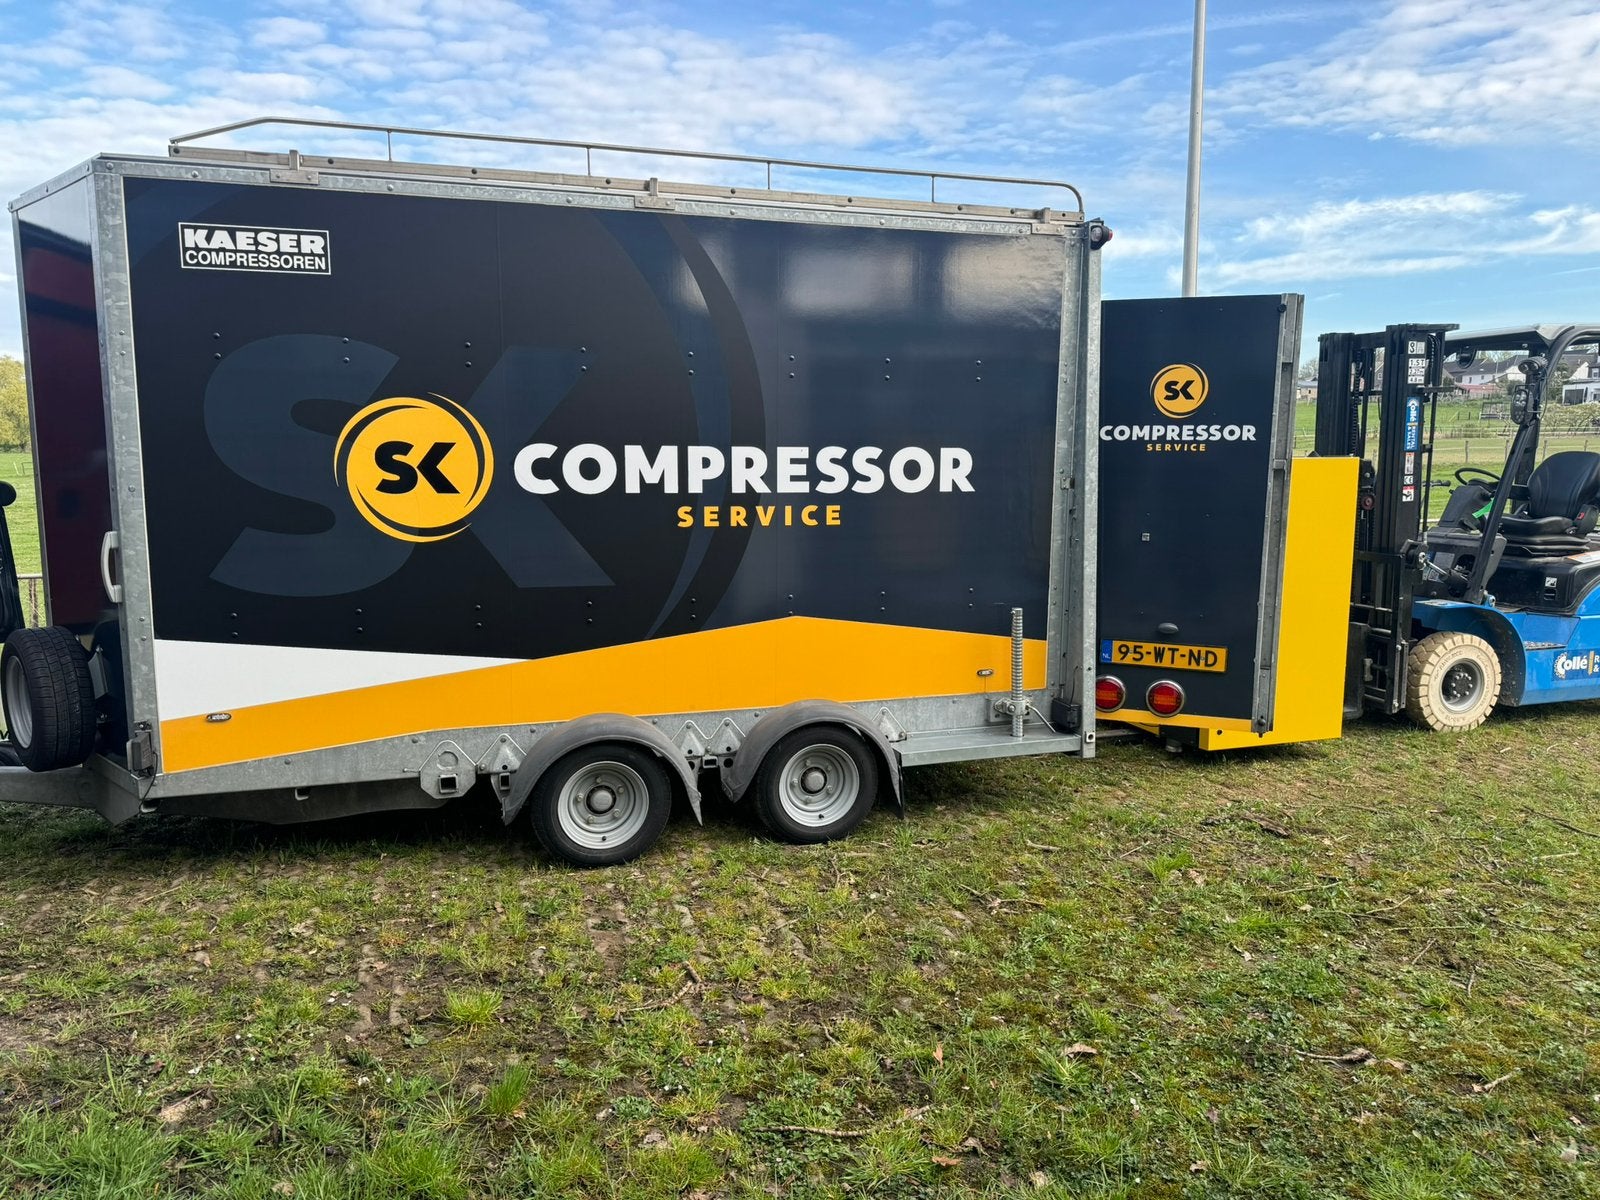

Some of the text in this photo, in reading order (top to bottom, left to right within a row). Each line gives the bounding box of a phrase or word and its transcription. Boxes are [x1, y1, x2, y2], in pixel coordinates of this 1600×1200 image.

[183, 228, 325, 254] KAESER
[185, 250, 326, 270] COMPRESSOREN
[1163, 380, 1195, 401] SK
[1407, 399, 1419, 422] Collé
[1099, 425, 1257, 441] COMPRESSOR
[1146, 443, 1206, 452] SERVICE
[374, 441, 461, 494] SK
[514, 443, 976, 496] COMPRESSOR
[677, 505, 841, 528] SERVICE
[1102, 652, 1111, 660] NL
[1118, 644, 1218, 668] 95-WT-ND
[1554, 651, 1588, 679] Collé
